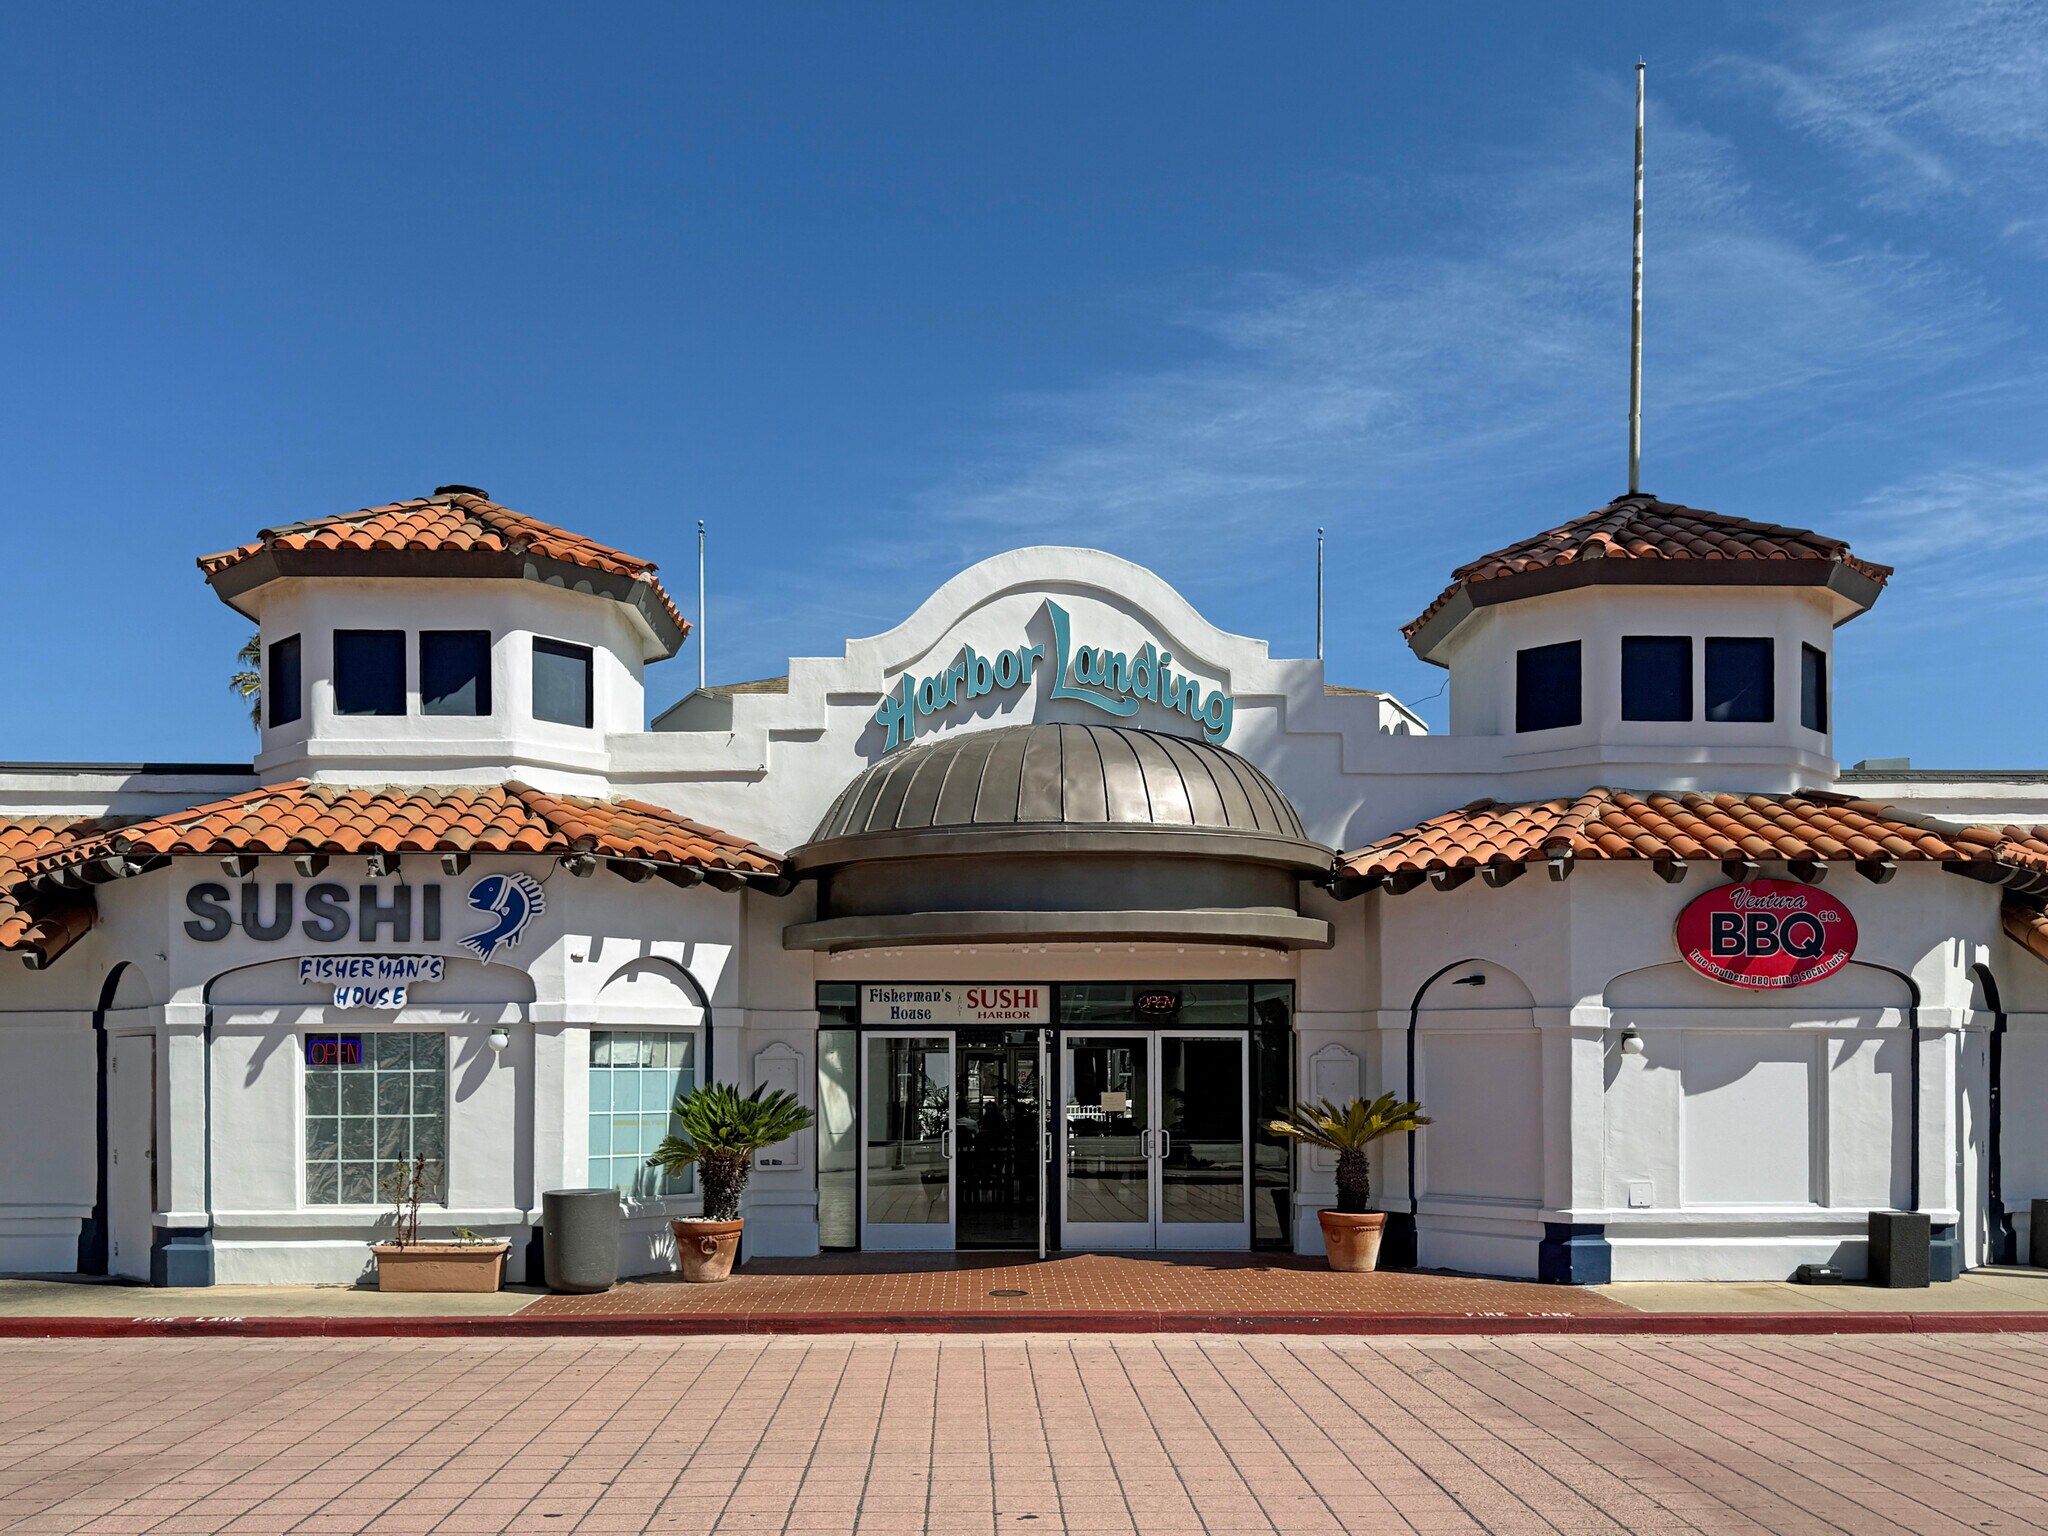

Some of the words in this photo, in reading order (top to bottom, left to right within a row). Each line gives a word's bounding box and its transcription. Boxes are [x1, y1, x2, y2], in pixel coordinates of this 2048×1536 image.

[876, 642, 1045, 754] Harbor
[1045, 597, 1236, 746] Landing
[1729, 886, 1808, 910] Ventura
[183, 882, 442, 943] SUSHI
[1710, 910, 1826, 961] BBQ
[1817, 910, 1841, 923] CO.
[299, 957, 443, 980] FISHERMAN'S
[1690, 949, 1708, 968] True
[1708, 963, 1749, 983] Southern
[1751, 976, 1770, 986] BBQ
[1771, 974, 1792, 986] with
[1793, 975, 1800, 985] a
[1799, 964, 1827, 982] SOCAL
[1827, 949, 1848, 970] twist
[336, 985, 406, 1006] HOUSE
[869, 988, 952, 1003] Fisherman's
[966, 988, 1039, 1009] SUSHI
[1138, 995, 1176, 1009] OPEN
[890, 1006, 932, 1020] House
[977, 1010, 1031, 1019] HARBOR
[310, 1042, 360, 1065] OPEN
